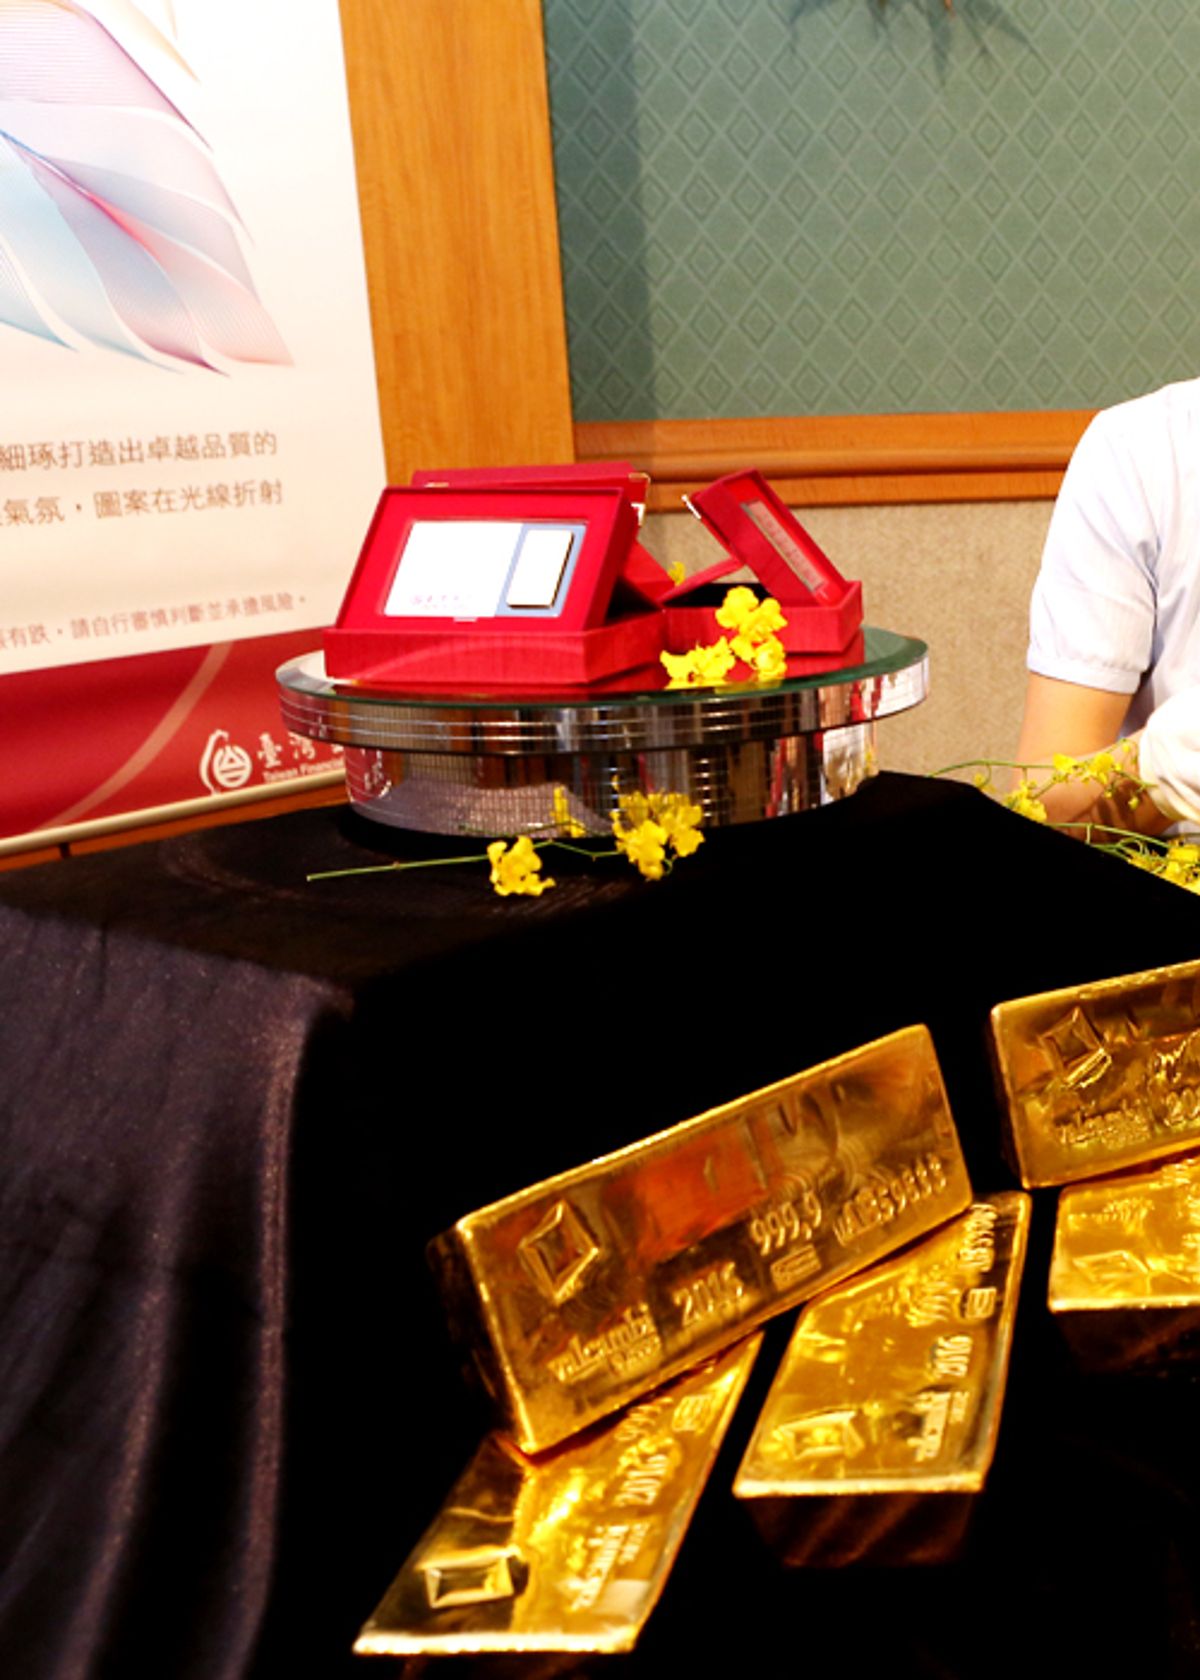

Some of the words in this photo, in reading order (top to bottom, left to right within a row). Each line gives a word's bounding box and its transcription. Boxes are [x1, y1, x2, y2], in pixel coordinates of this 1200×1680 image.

[0, 478, 283, 527] 氣氛，圖案在光線折射
